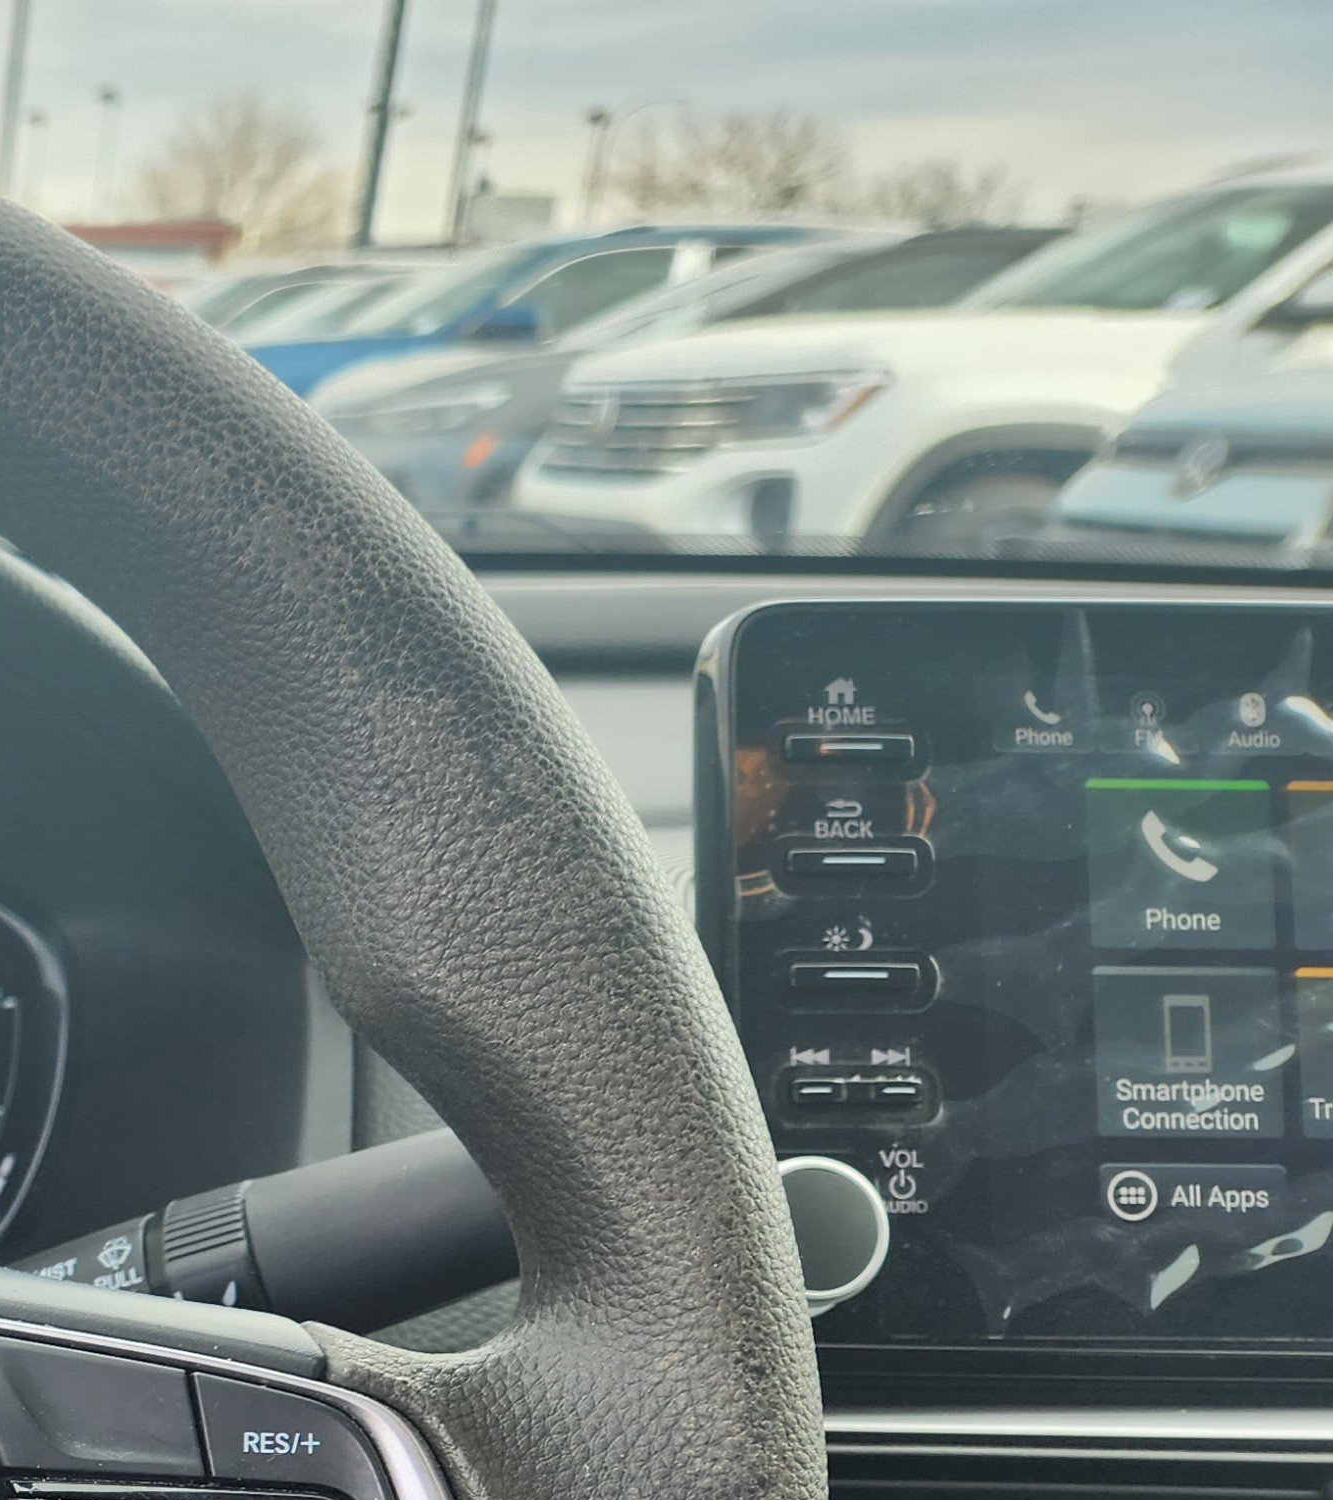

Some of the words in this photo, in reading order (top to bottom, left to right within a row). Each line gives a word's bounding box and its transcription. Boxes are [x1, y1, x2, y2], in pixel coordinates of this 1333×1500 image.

[808, 706, 875, 726] HOME
[1015, 728, 1073, 747] Phone
[1134, 728, 1164, 746] FM
[1228, 728, 1281, 749] Audio
[815, 820, 874, 839] BACK
[1146, 908, 1222, 932] Phone
[1115, 1078, 1265, 1113] Smartphone
[1122, 1106, 1260, 1132] Connection
[879, 1149, 925, 1168] VOL
[1171, 1183, 1202, 1207] All
[1208, 1183, 1270, 1211] Apps
[35, 1258, 78, 1281] IST
[93, 1268, 144, 1290] PULL
[242, 1432, 322, 1456] RES/+
